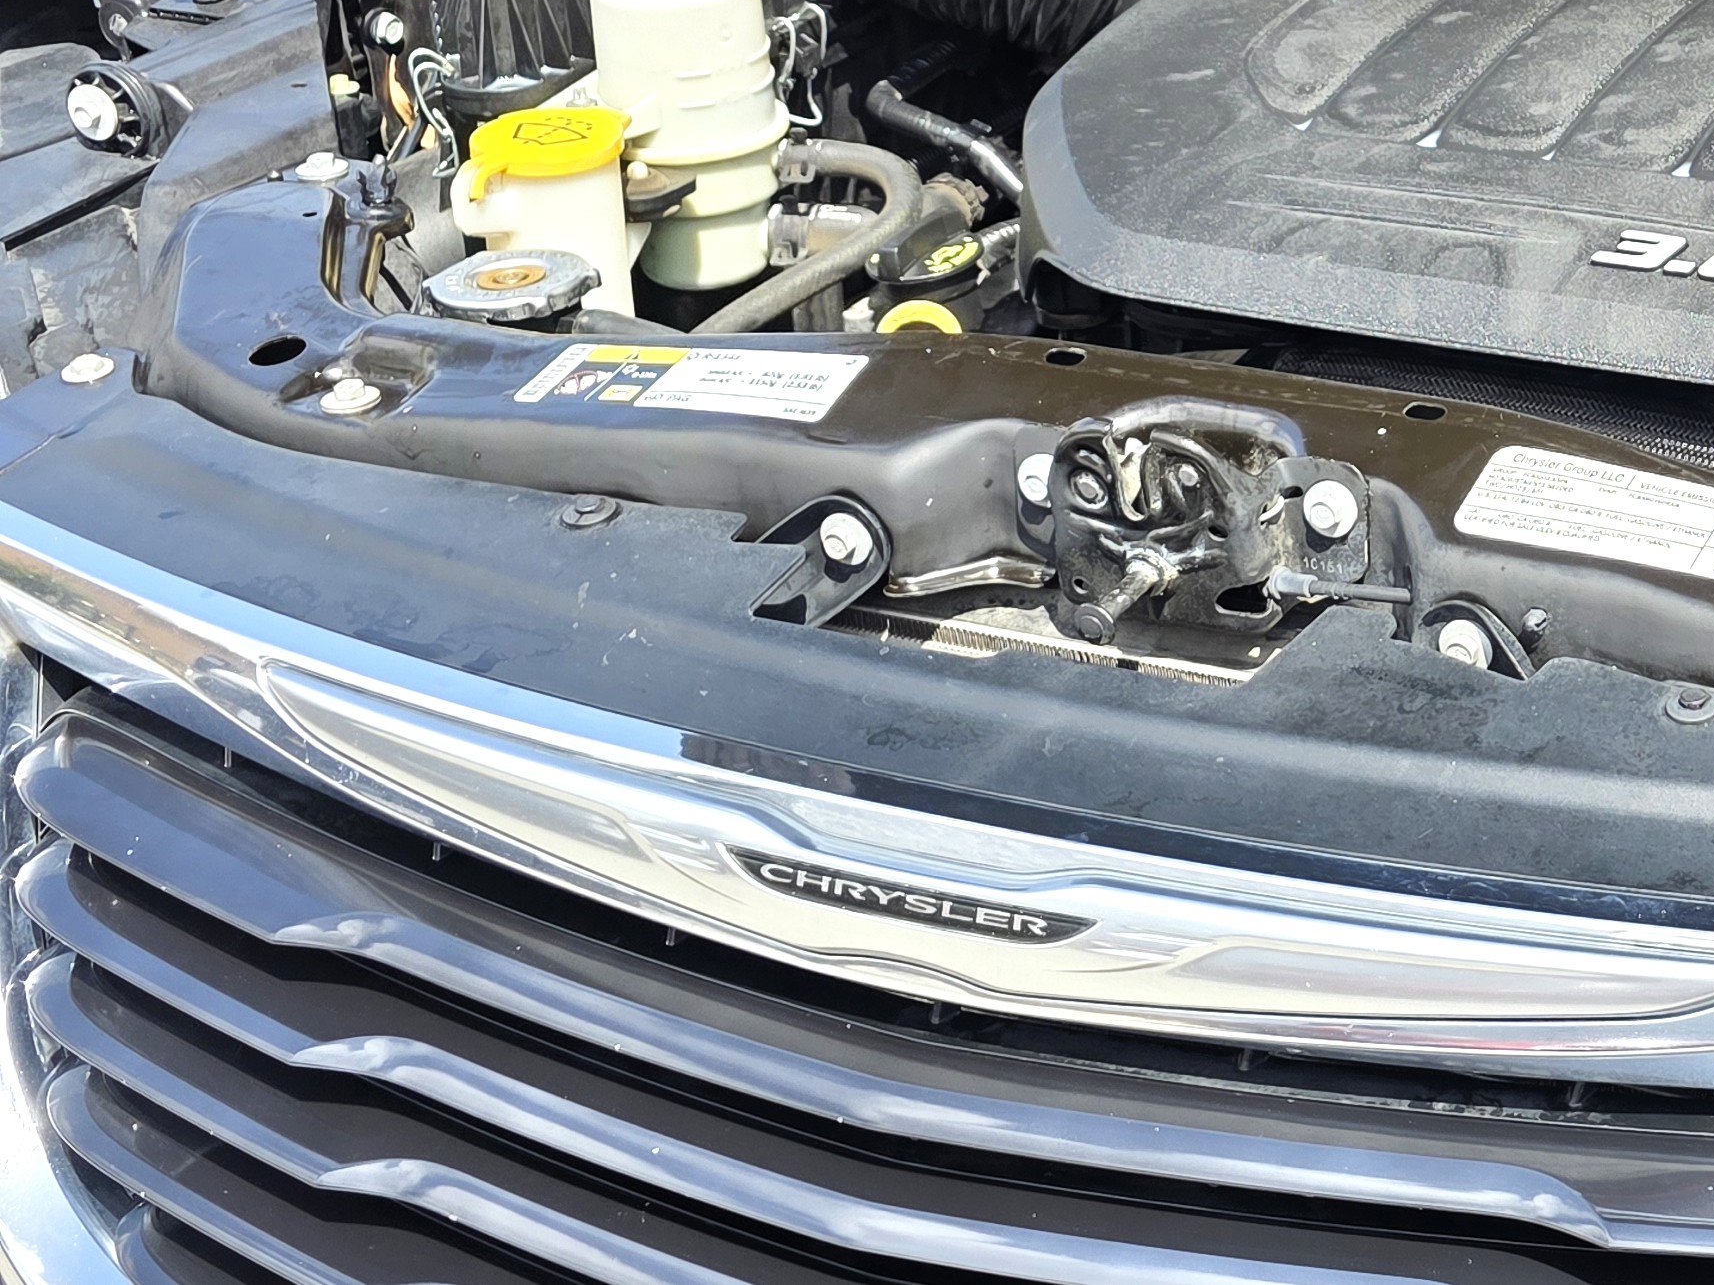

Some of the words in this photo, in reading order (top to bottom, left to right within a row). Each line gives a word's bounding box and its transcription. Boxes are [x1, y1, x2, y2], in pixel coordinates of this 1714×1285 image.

[1513, 452, 1560, 472] Chrysler
[1563, 462, 1599, 478] Group
[1600, 470, 1626, 483] LLC
[1640, 481, 1680, 497] VEHICLE
[759, 862, 1048, 937] CHRYSLER
